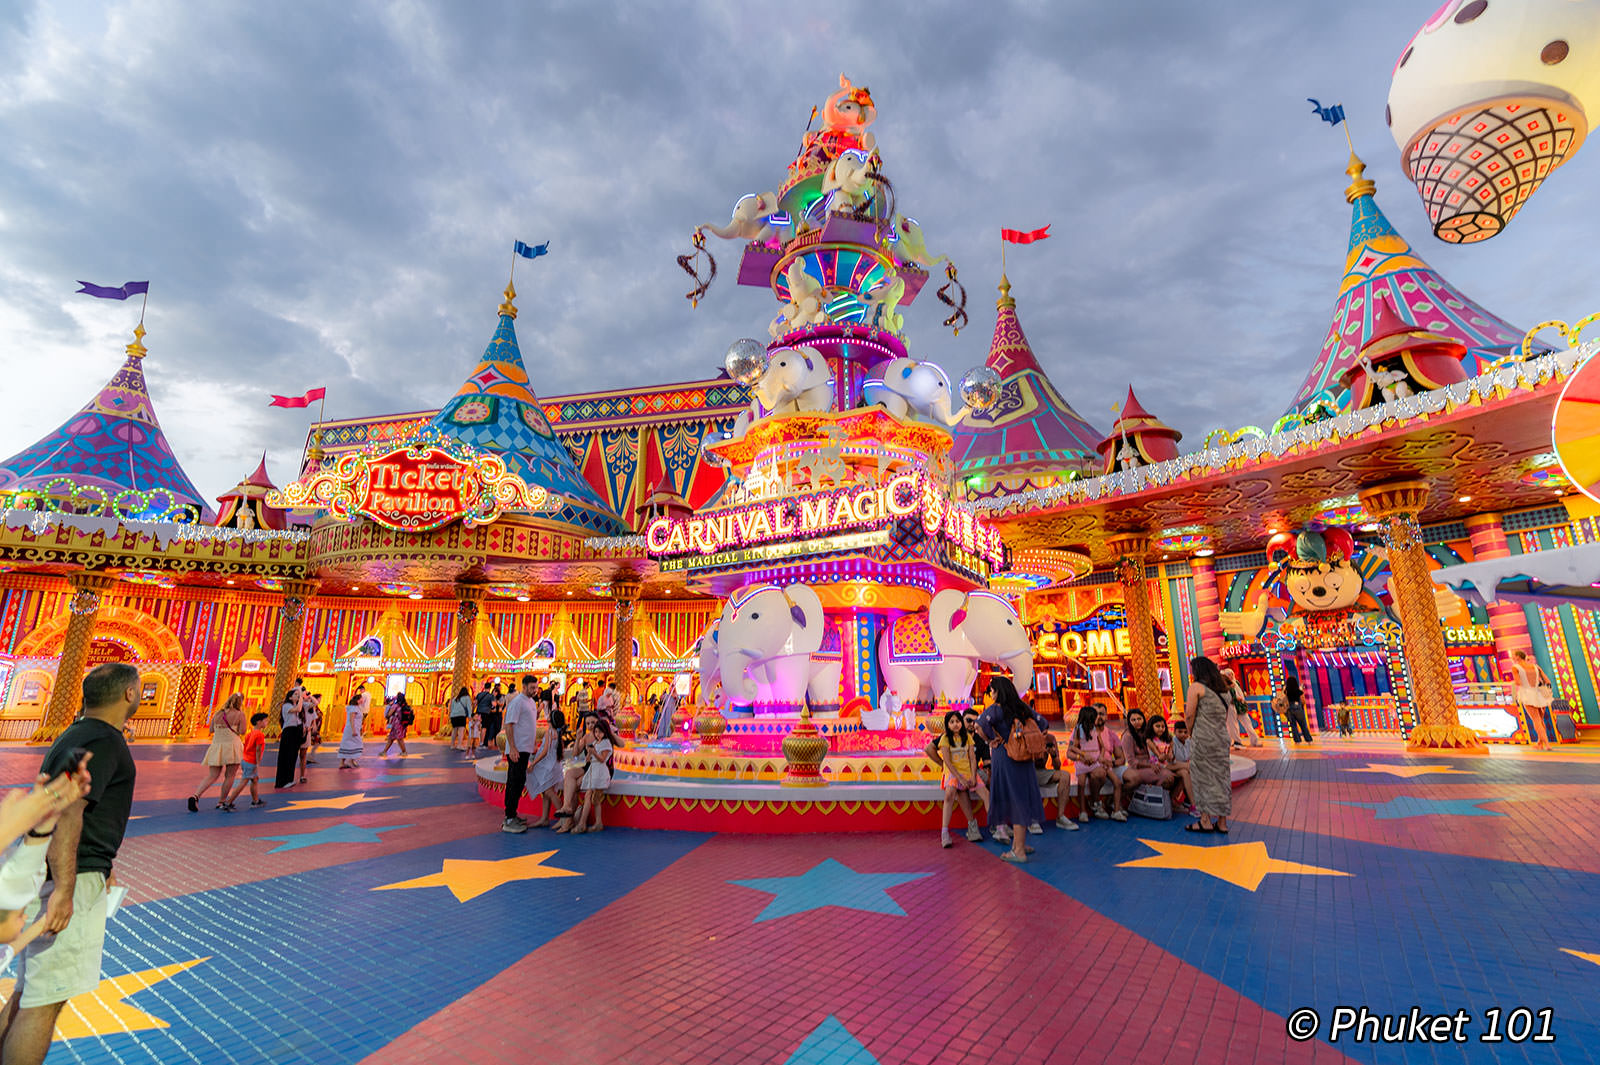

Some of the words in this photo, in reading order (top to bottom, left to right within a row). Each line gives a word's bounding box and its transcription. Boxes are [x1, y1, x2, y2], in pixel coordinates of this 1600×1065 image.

[370, 463, 462, 490] Ticket
[368, 491, 456, 512] Pavilion
[646, 504, 795, 554] CARNIVAL
[801, 471, 921, 530] MAGIC
[662, 559, 683, 571] THE
[687, 551, 738, 567] MAGICAL
[1446, 628, 1496, 642] CREAM
